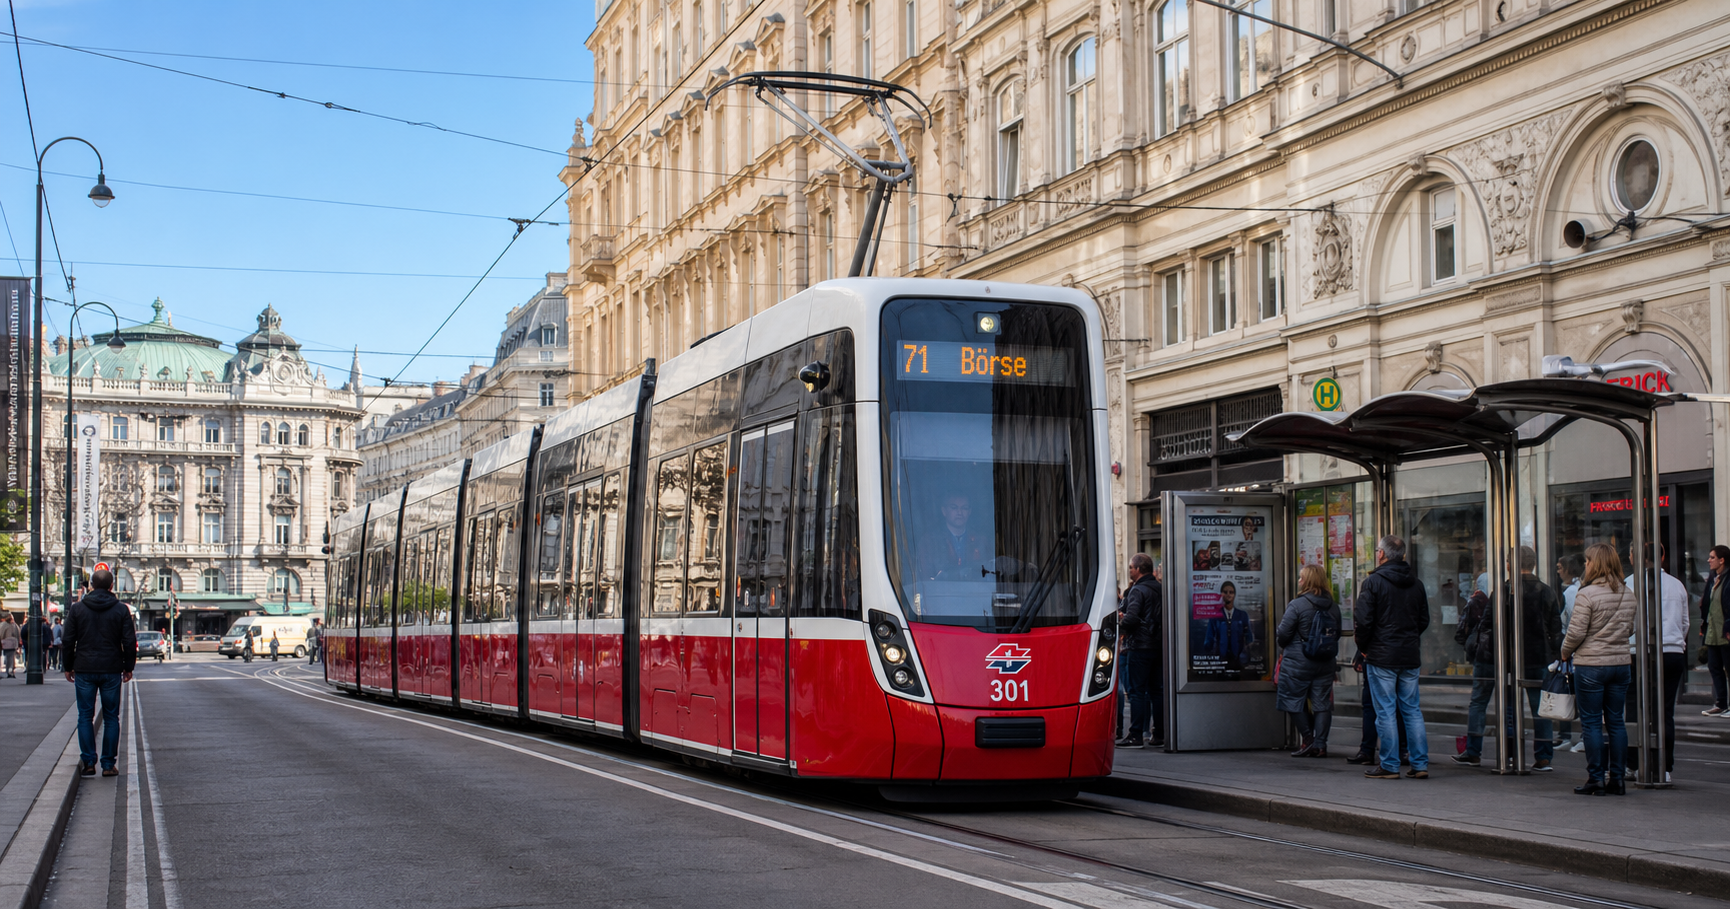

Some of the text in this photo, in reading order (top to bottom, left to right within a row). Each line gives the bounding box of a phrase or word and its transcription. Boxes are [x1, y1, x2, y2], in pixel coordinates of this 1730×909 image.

[903, 344, 1027, 377] 71 Börse
[1606, 370, 1671, 393] RICK
[1320, 385, 1335, 405] H
[990, 679, 1029, 702] 301
